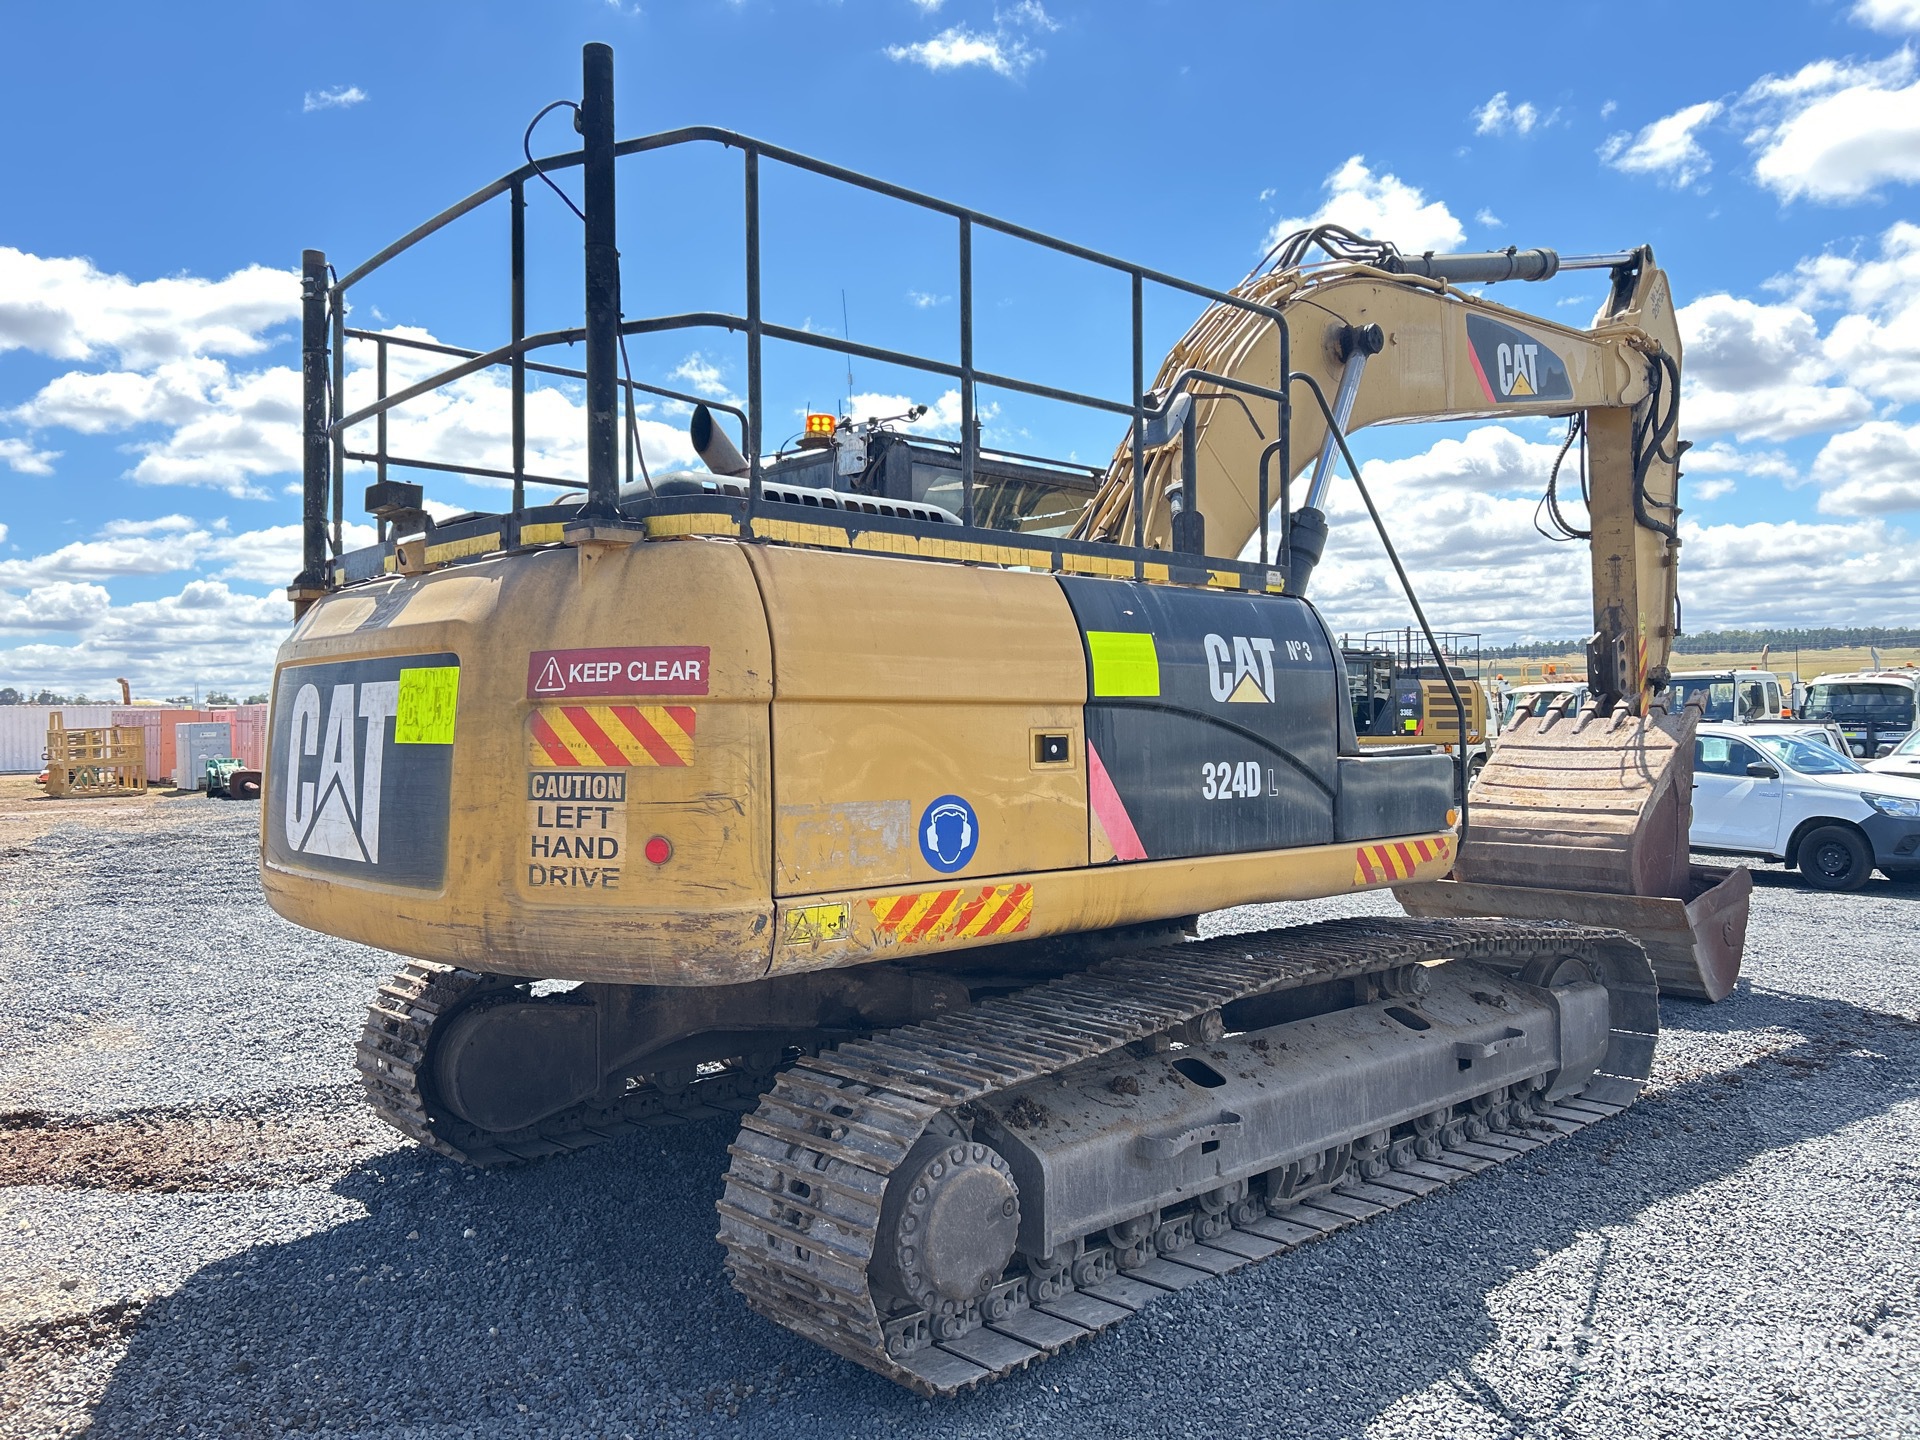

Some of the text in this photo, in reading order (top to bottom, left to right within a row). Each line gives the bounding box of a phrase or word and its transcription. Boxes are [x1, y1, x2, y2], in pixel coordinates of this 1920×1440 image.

[1497, 343, 1538, 396] CAT
[568, 660, 701, 683] KEEP CLEAR
[1203, 633, 1275, 703] CAT
[286, 680, 400, 865] CAT
[1202, 761, 1279, 800] 324D L
[531, 774, 623, 799] CAUTION
[538, 805, 614, 829] LEFT
[531, 835, 619, 859] HAND
[528, 863, 620, 889] DRIVE
